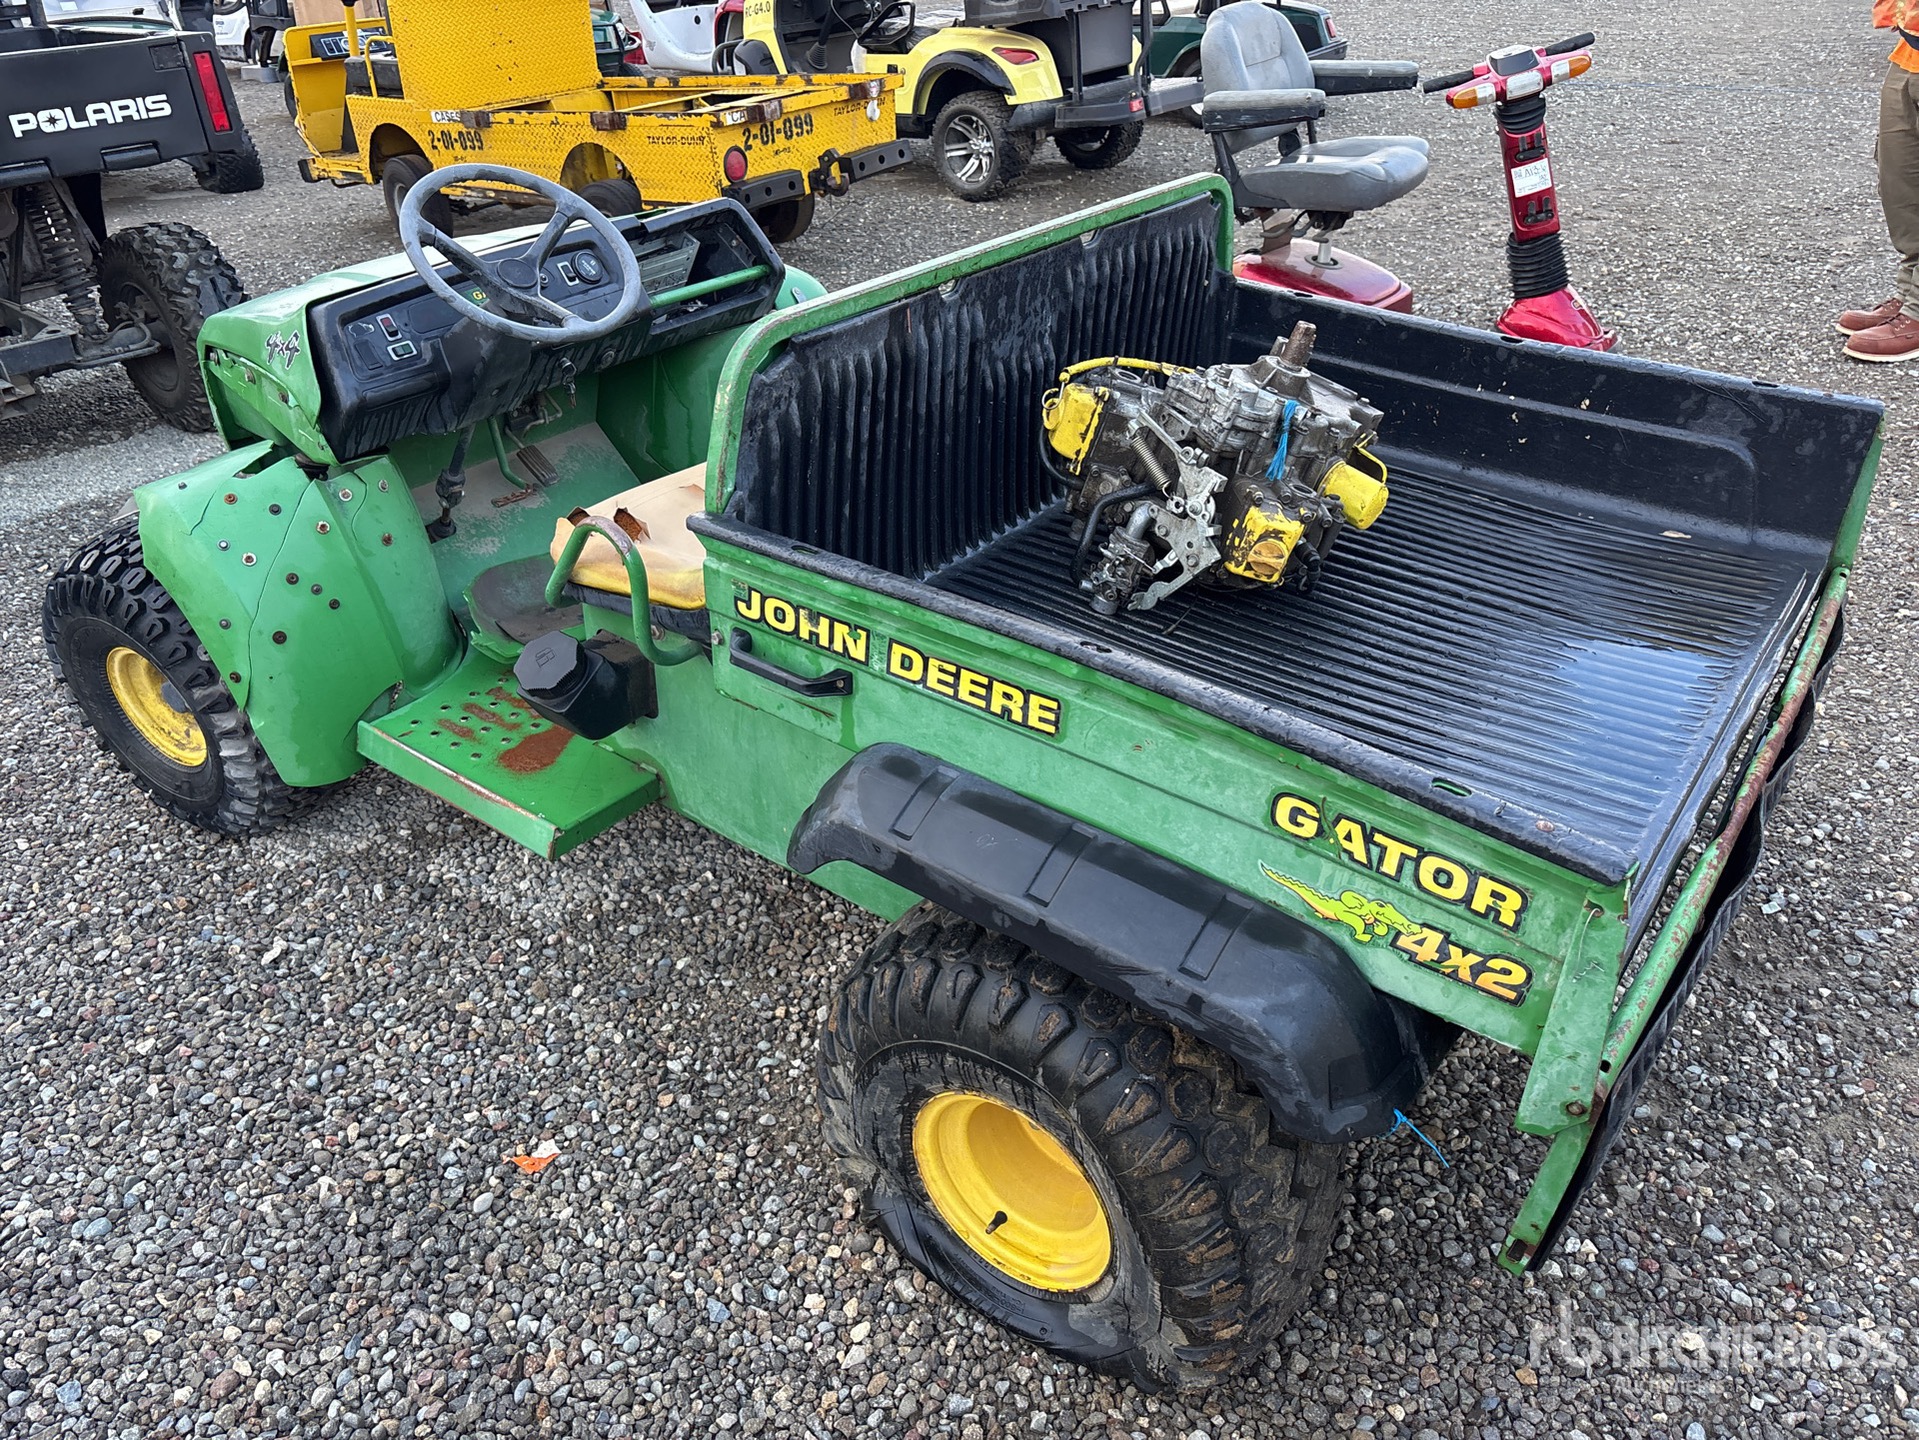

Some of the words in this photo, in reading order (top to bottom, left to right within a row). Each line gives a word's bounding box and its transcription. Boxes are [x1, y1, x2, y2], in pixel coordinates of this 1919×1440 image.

[8, 94, 172, 138] POLARIS
[742, 113, 814, 151] 2-01-099
[427, 130, 484, 151] 2-01-099
[647, 134, 706, 147] TAYLOR-DUNN
[734, 586, 870, 666] JOHN
[886, 638, 1061, 737] DEERE
[1271, 792, 1533, 932] GATOR
